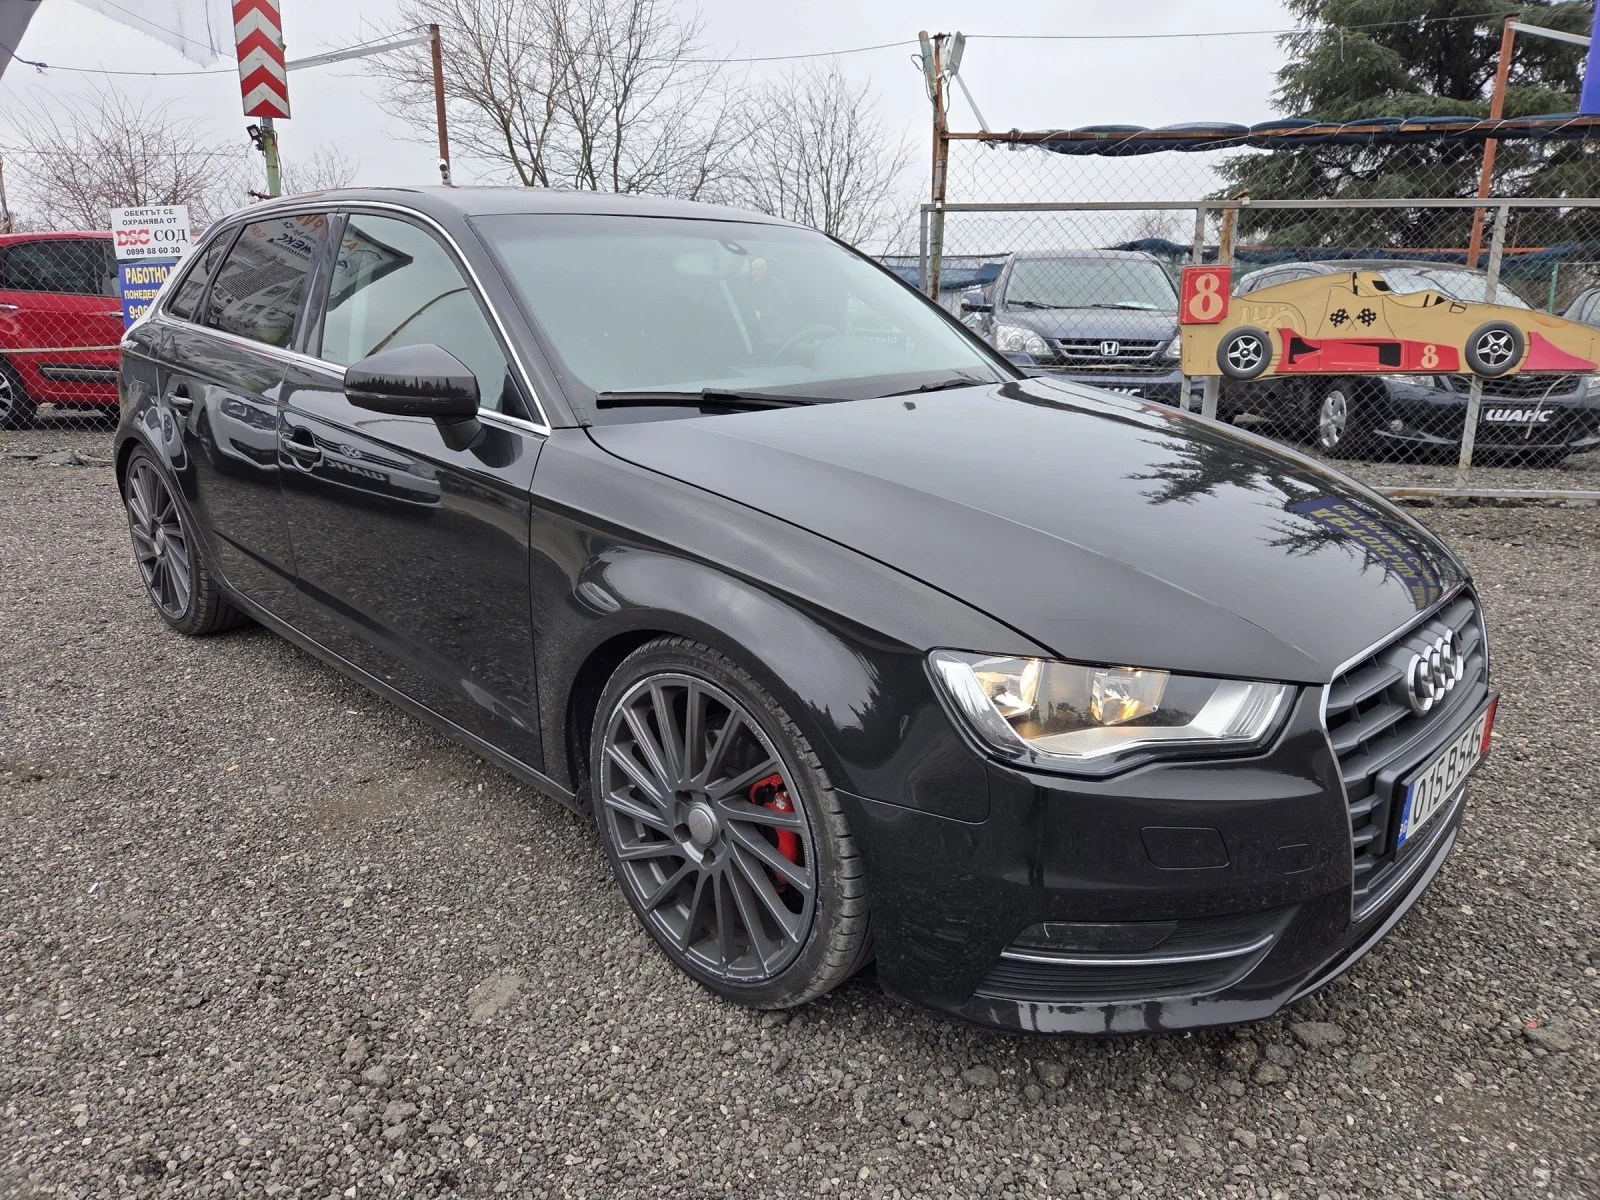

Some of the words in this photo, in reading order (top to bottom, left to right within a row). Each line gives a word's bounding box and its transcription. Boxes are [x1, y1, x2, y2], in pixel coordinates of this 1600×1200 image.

[124, 209, 161, 217] ОБЕКТЪТ
[122, 218, 165, 226] ОХРАНЯВА
[116, 229, 150, 246] DSC
[154, 229, 188, 243] СОД
[170, 246, 181, 254] 30
[125, 266, 168, 284] РАБОТНО
[1188, 273, 1224, 321] 8
[1420, 344, 1440, 369] 8
[1485, 408, 1555, 423] ШАНС
